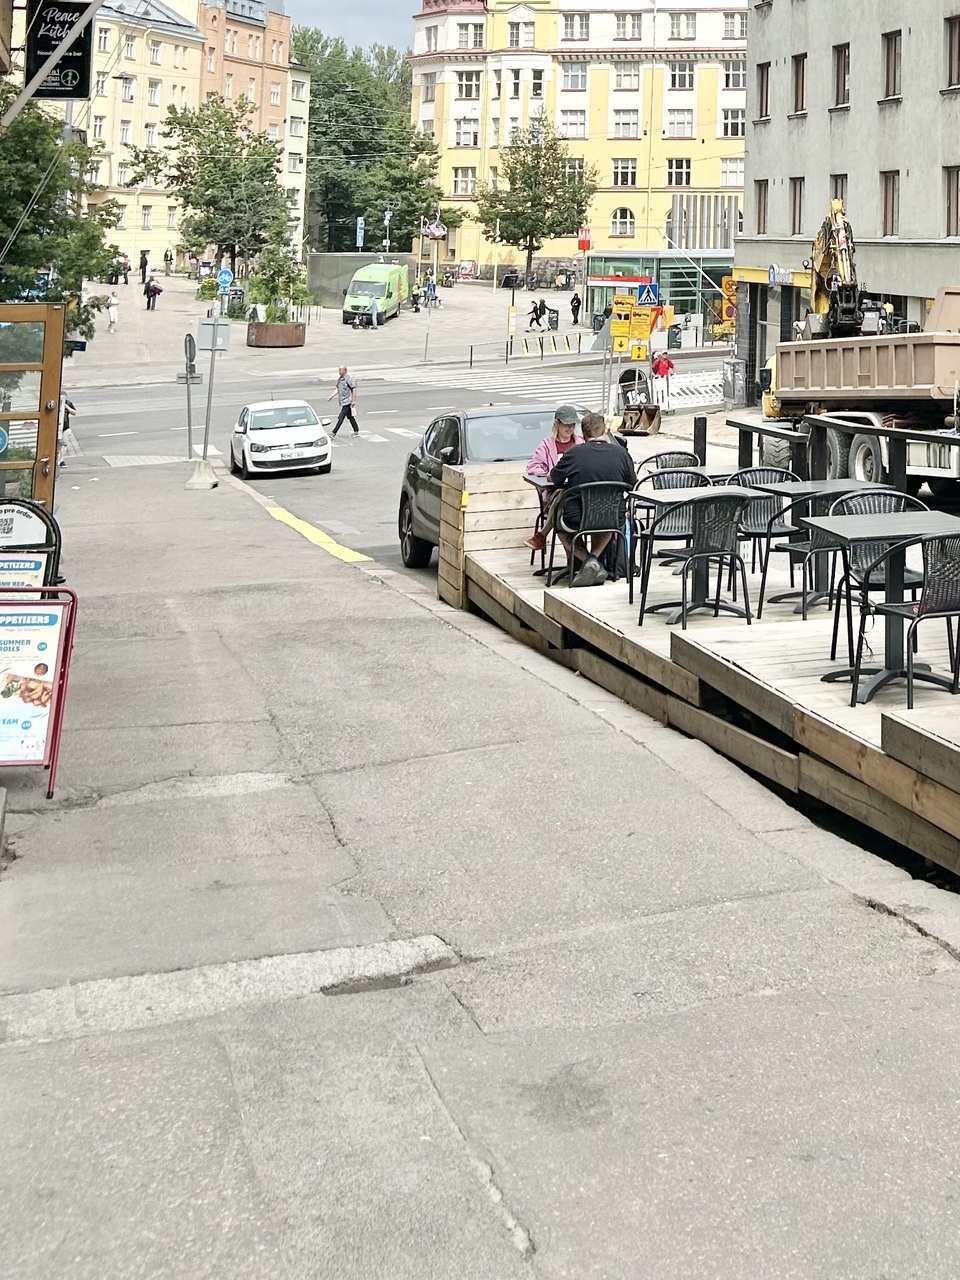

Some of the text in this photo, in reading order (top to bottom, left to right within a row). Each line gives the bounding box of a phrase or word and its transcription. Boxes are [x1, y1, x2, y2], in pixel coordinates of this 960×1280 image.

[42, 7, 80, 22] Peace
[37, 23, 84, 38] Kitchn
[16, 509, 33, 520] order
